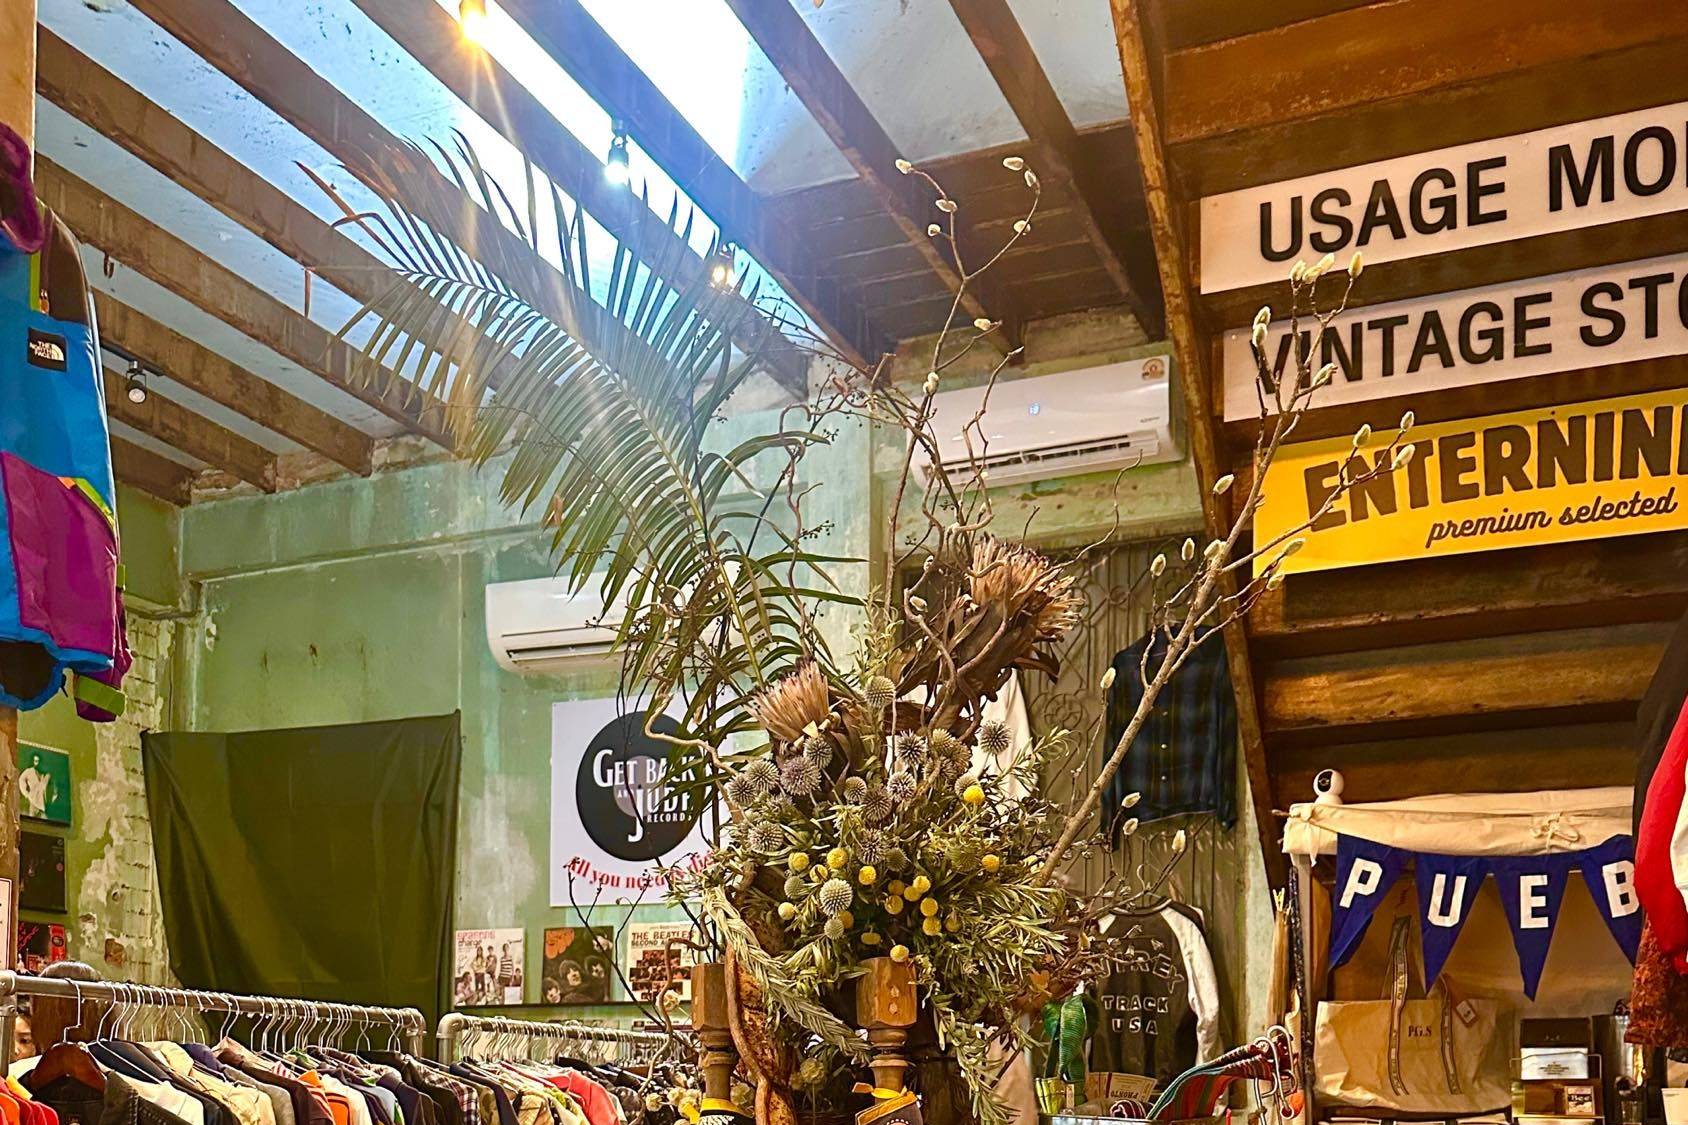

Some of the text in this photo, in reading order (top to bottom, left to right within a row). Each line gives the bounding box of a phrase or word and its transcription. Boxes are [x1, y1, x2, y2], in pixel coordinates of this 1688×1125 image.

[1259, 121, 1688, 262] USAGE MO
[1250, 292, 1553, 396] VINTAGE
[1425, 487, 1678, 548] premium selected
[593, 749, 696, 787] GET BAK
[590, 871, 620, 889] you
[632, 932, 648, 940] THE
[1101, 994, 1168, 1013] TRACK
[1112, 1016, 1158, 1035] USA
